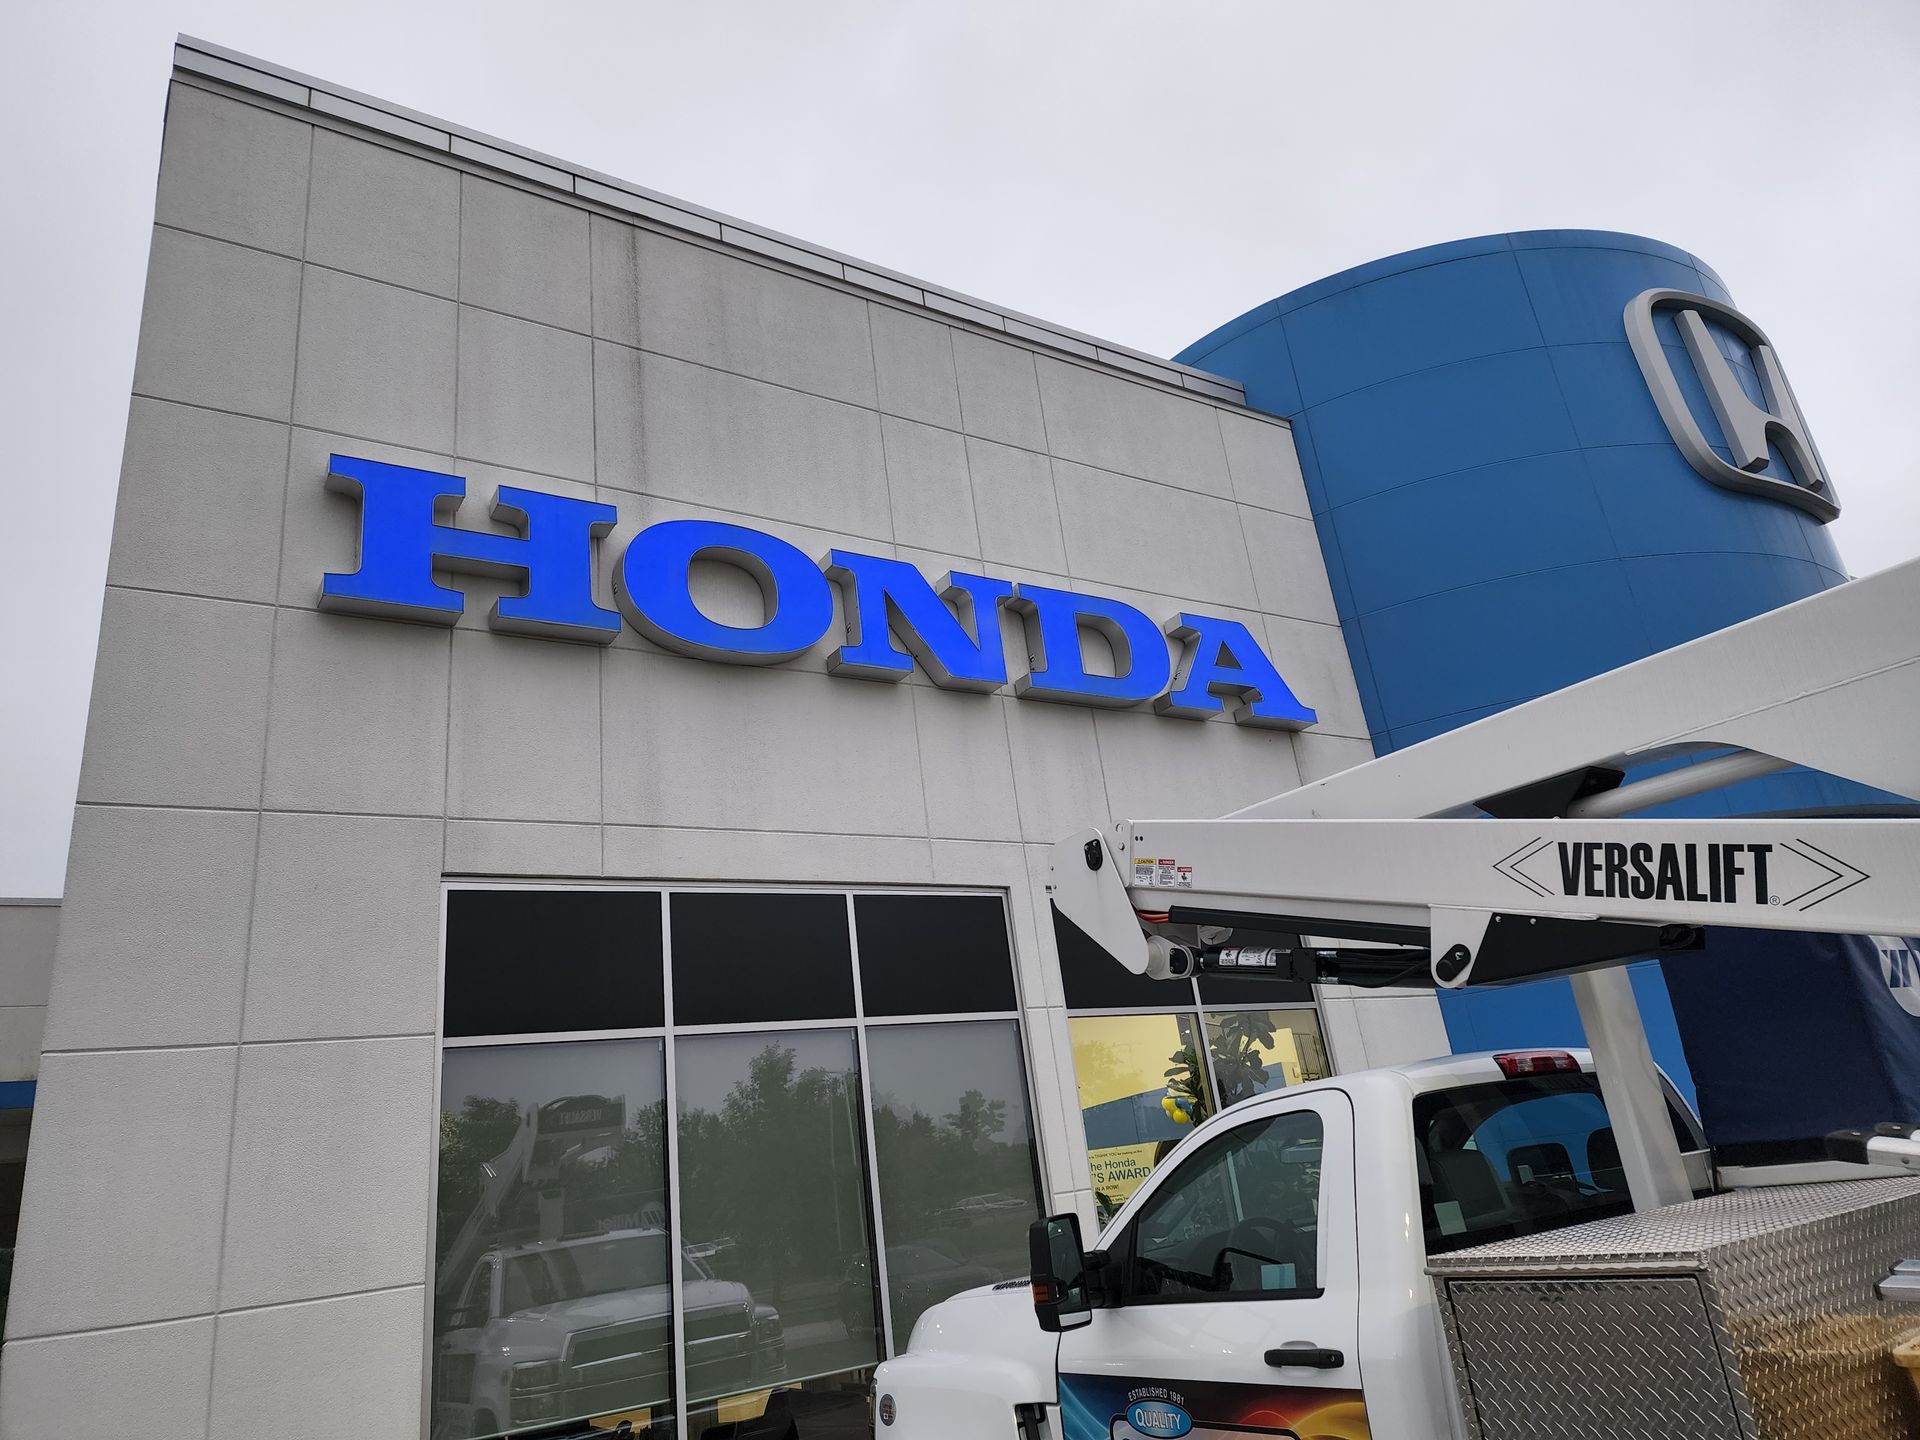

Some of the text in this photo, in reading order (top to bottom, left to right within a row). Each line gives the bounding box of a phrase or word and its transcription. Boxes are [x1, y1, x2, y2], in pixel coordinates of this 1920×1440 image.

[322, 455, 1317, 728] HONDA
[1557, 841, 1774, 905] VERSALIFT
[1105, 1158, 1136, 1170] Honda
[1128, 1387, 1184, 1405] ESTABLISHED 1981
[1135, 1408, 1181, 1430] QUALITY
